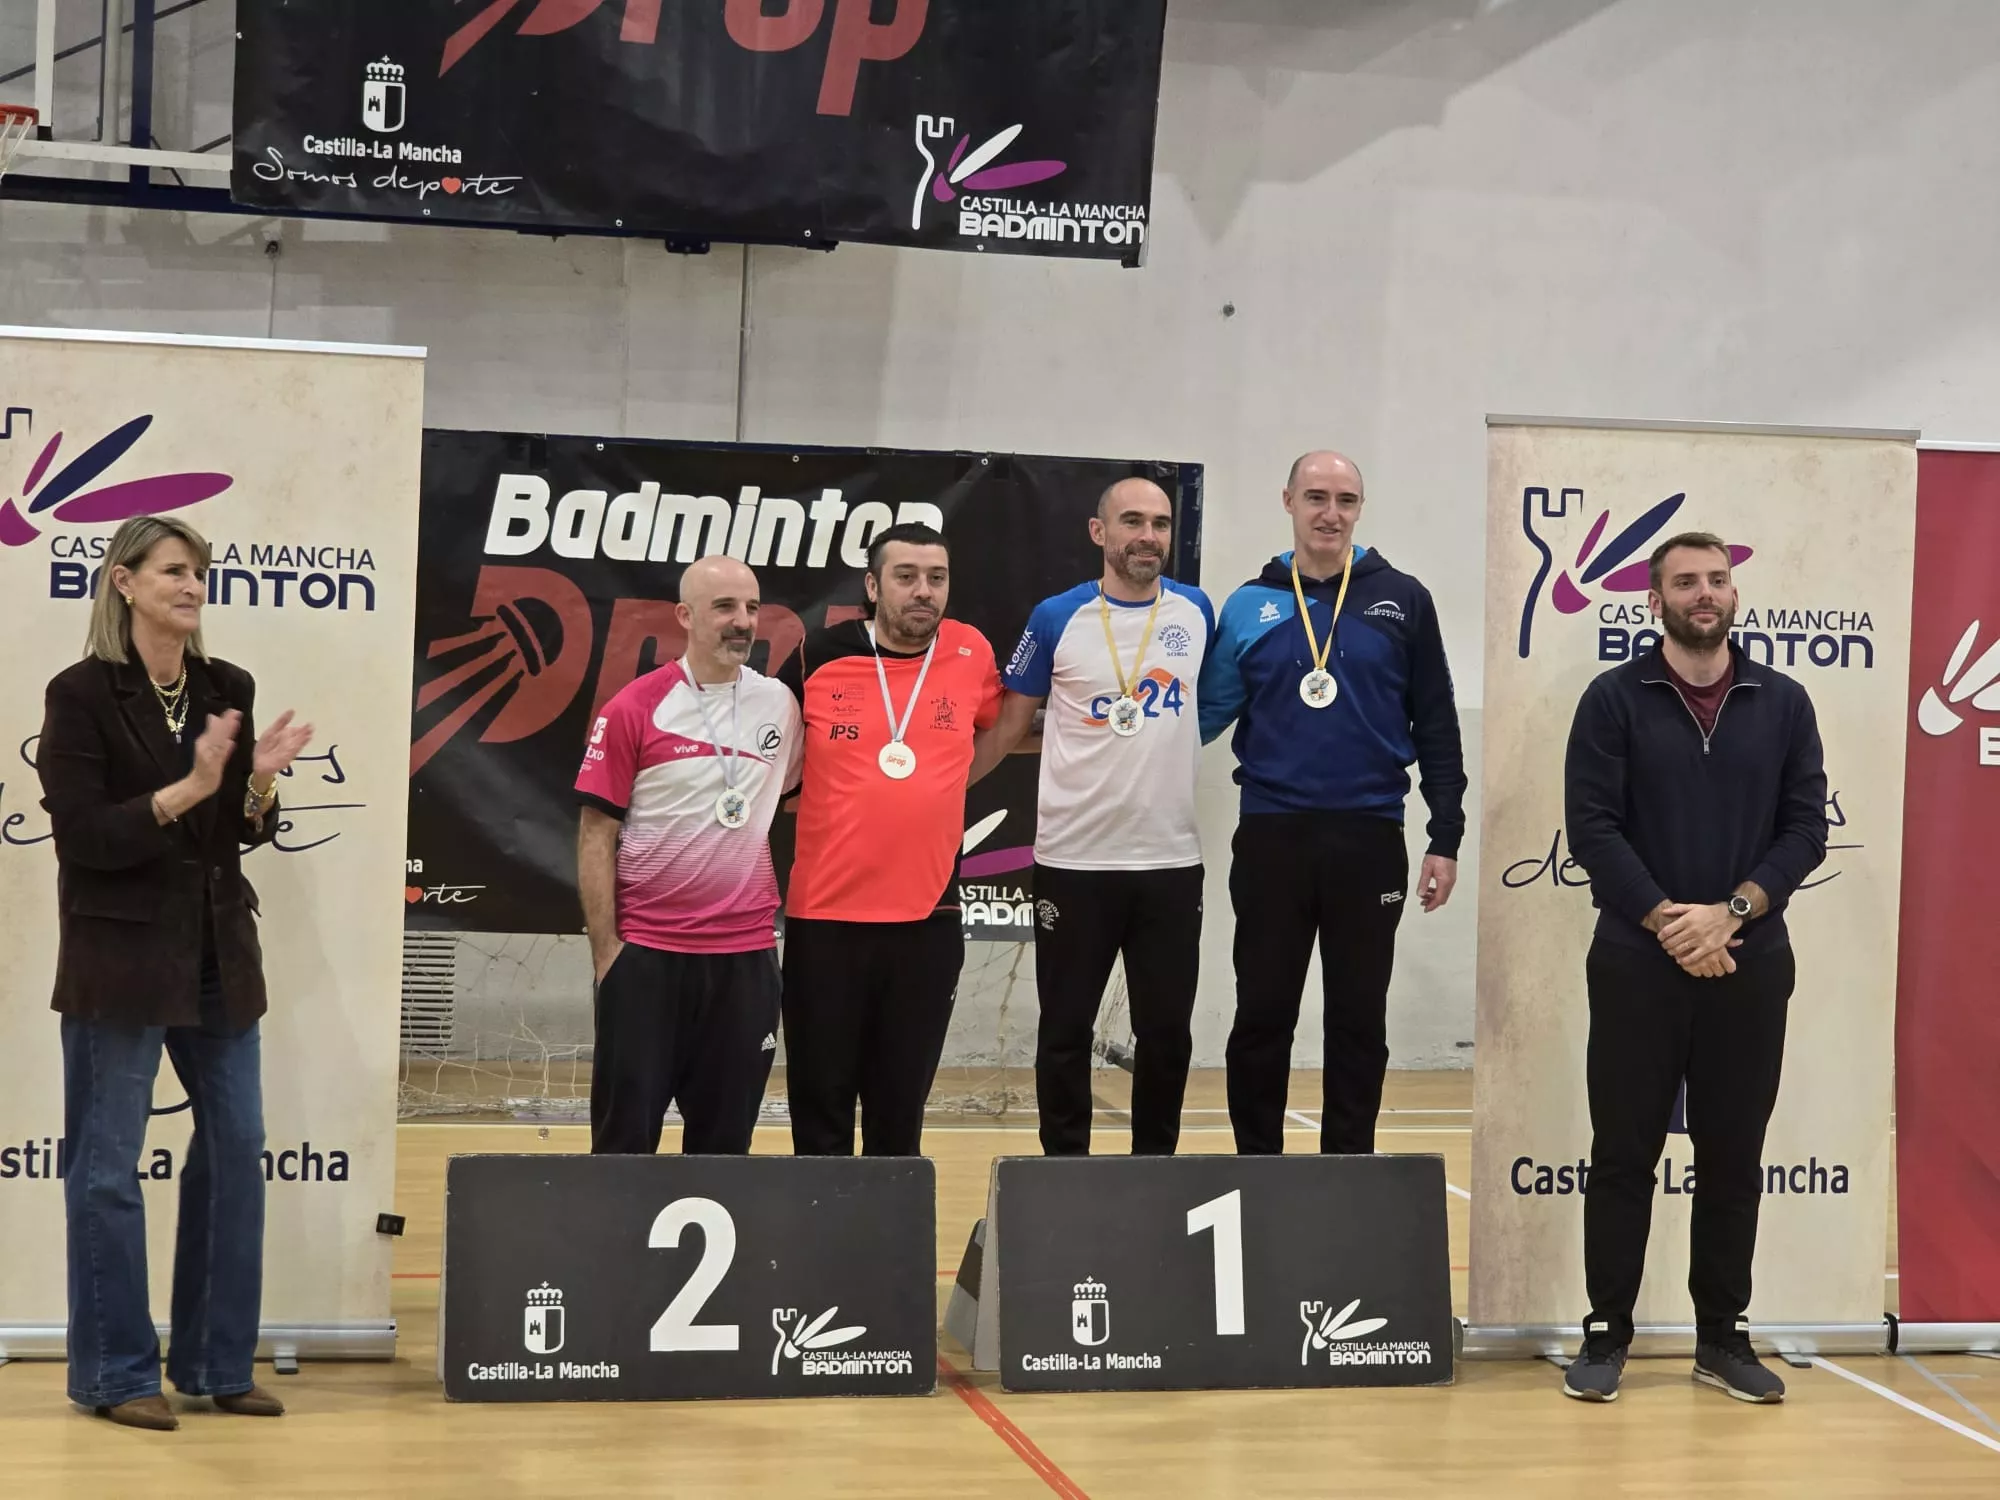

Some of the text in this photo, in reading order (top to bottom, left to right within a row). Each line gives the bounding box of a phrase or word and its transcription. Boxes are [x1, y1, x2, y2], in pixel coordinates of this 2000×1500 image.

[302, 135, 462, 164] Castilla-La Mancha
[252, 146, 358, 181] Somos
[960, 196, 1037, 215] CASTILLA
[1050, 202, 1070, 217] LA
[1074, 203, 1146, 221] MANCHA
[959, 211, 1146, 244] BADMINTON
[250, 543, 376, 571] MANCHA
[1767, 608, 1874, 632] MANCHA
[829, 725, 859, 741] JPS
[1187, 1189, 1245, 1335] 1
[648, 1197, 740, 1352] 2
[867, 1350, 912, 1360] MANCHA
[1389, 1341, 1431, 1350] MANCHA
[802, 1360, 913, 1376] BADMINTON
[1022, 1352, 1161, 1371] Castilla-La Mancha
[1329, 1350, 1432, 1366] BADMINTON
[468, 1361, 619, 1380] Castilla-La Mancha
